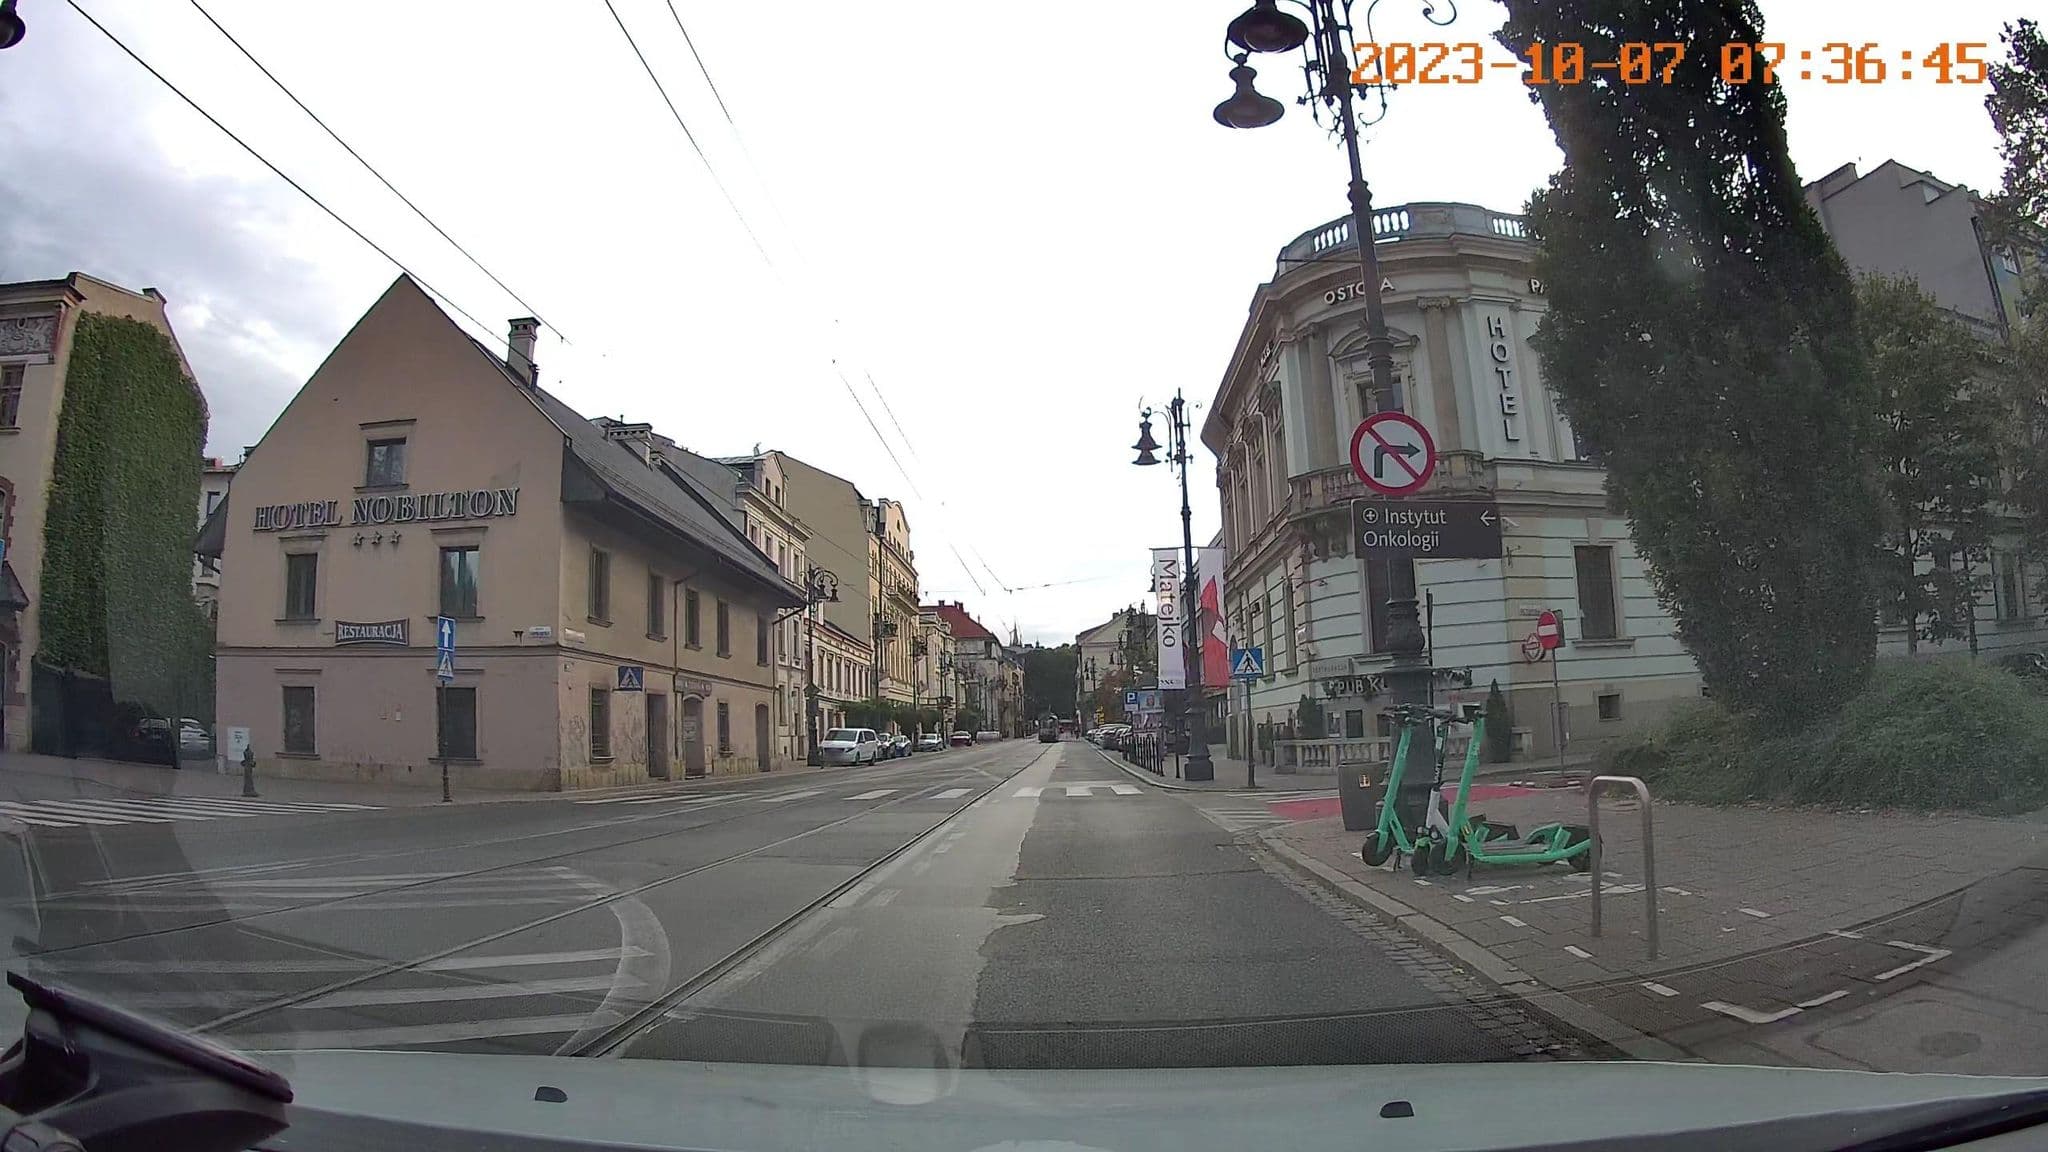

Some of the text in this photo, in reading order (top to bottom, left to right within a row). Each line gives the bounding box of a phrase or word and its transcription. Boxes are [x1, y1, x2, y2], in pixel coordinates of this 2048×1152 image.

[1324, 277, 1395, 304] OSTOA
[1487, 316, 1519, 441] HOTEL
[252, 487, 520, 531] HOTEL NOBILTON
[1384, 507, 1447, 528] Instytut
[1363, 529, 1439, 551] Onkologii
[1158, 559, 1180, 648] Matejko
[338, 623, 403, 640] RESTAURACJA
